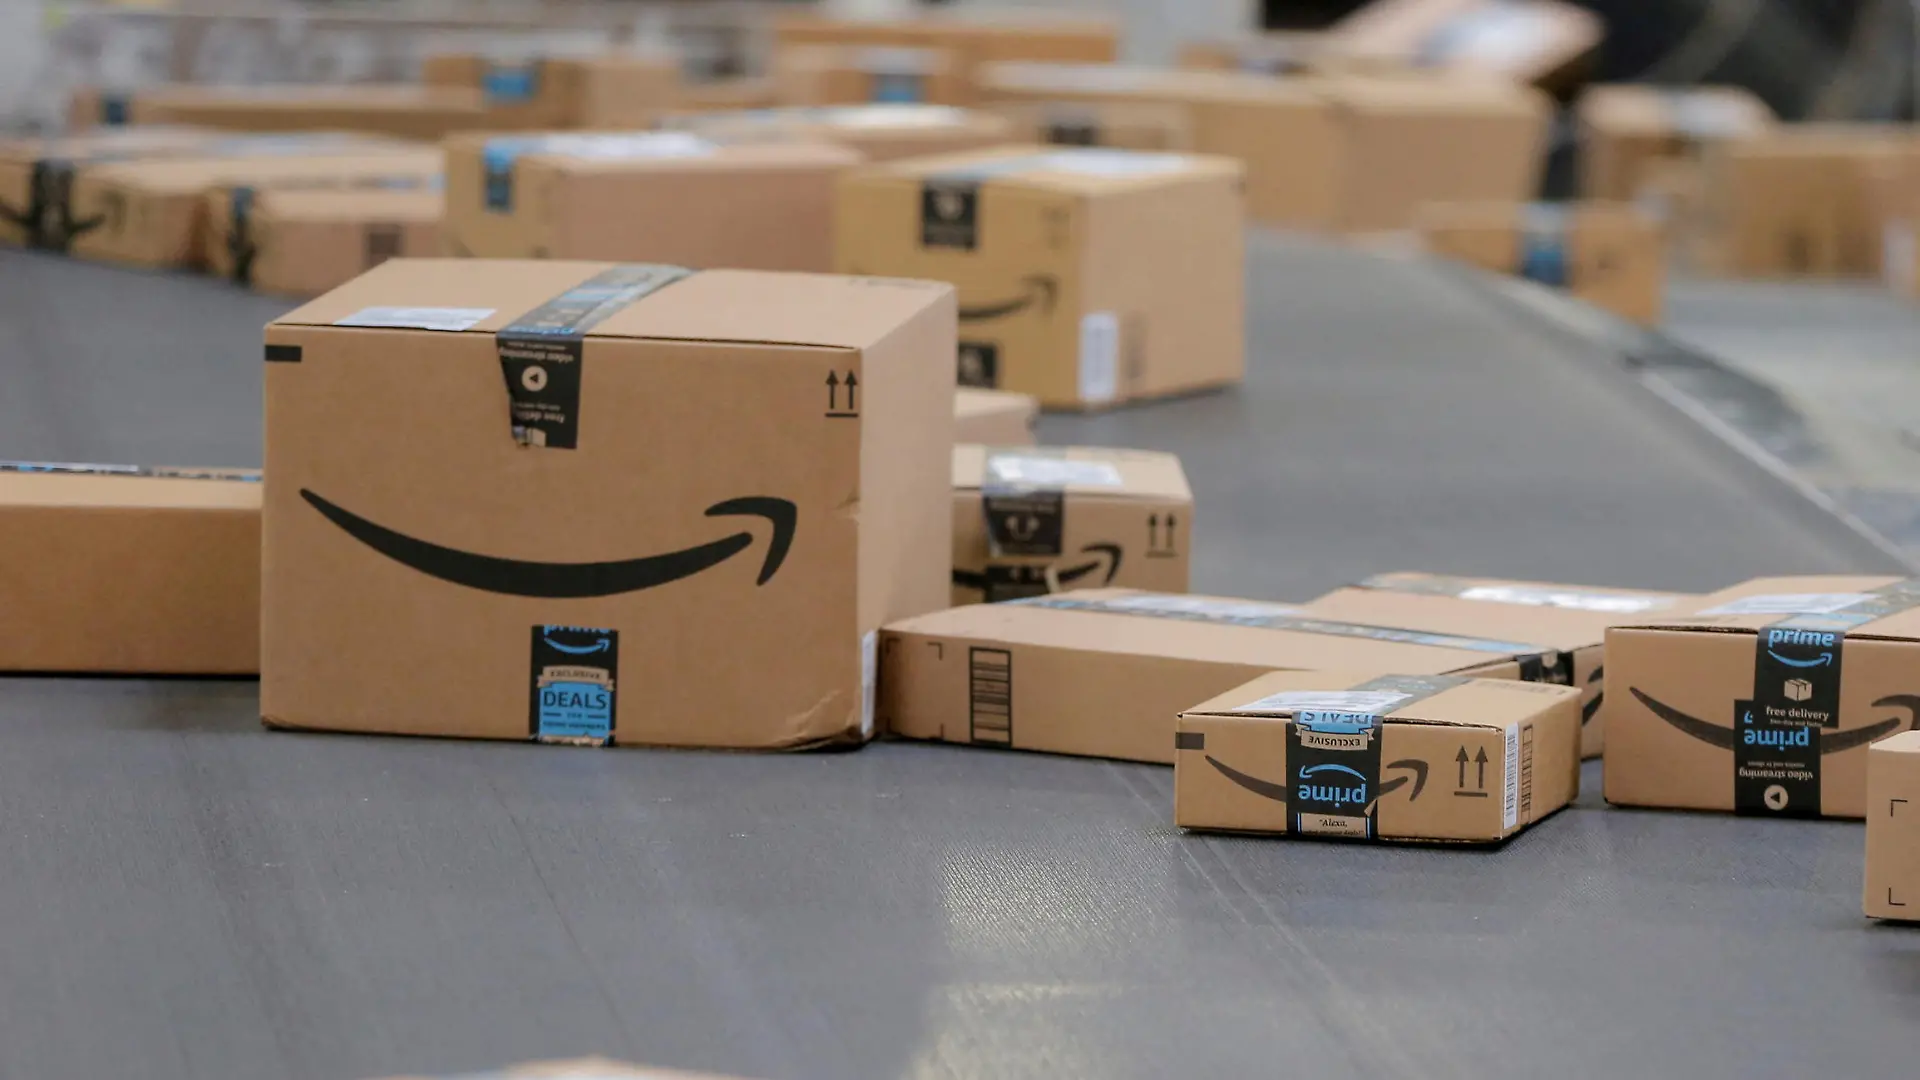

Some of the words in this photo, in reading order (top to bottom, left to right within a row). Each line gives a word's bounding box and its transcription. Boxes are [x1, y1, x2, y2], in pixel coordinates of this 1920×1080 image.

[1767, 629, 1836, 648] prime
[543, 691, 607, 710] DEALS
[1766, 705, 1786, 716] free
[1788, 708, 1829, 722] delivery
[1308, 735, 1361, 747] EXCLUSIVE
[1744, 726, 1809, 752] prime
[1739, 766, 1785, 780] streaming
[1787, 770, 1814, 781] video
[1299, 783, 1367, 808] prime
